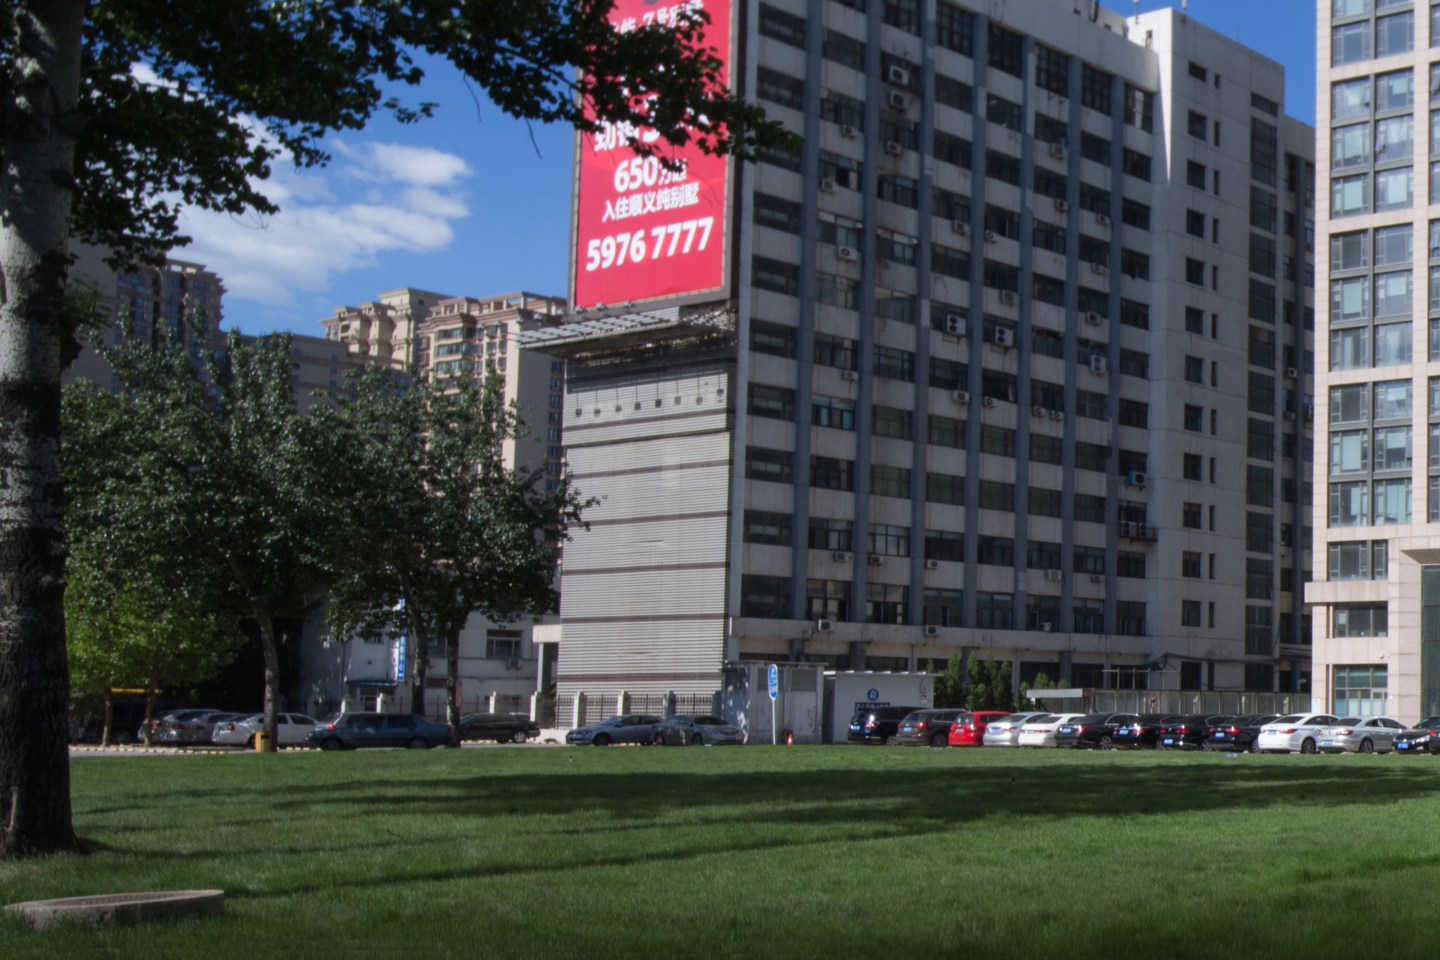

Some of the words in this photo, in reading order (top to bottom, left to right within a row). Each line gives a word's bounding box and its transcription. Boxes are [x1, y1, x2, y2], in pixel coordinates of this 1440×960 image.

[602, 182, 699, 222] 入住顺义纯别墅
[586, 229, 646, 271] 5976
[651, 216, 714, 259] 7777
